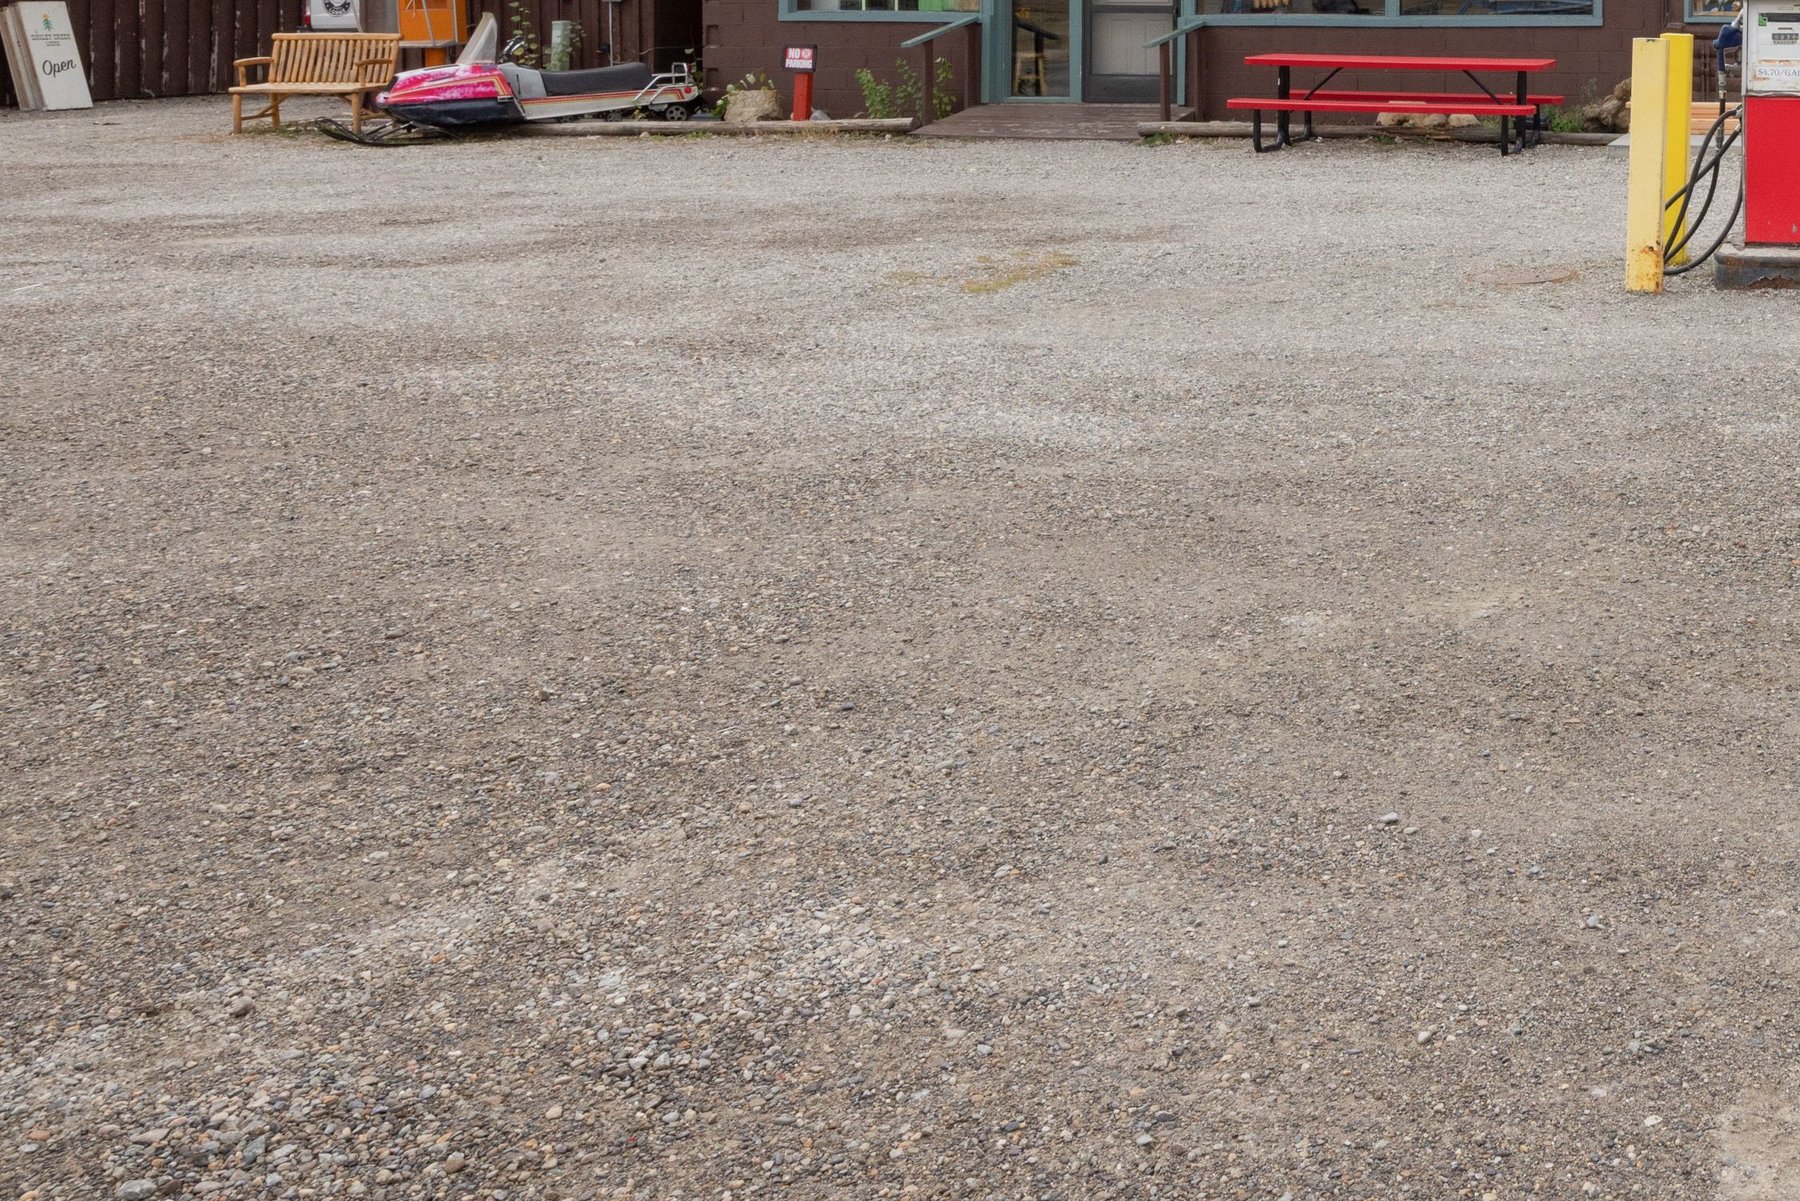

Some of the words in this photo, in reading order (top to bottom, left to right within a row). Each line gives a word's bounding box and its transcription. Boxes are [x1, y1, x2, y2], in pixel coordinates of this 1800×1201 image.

[788, 48, 800, 59] NO
[42, 59, 77, 78] Open
[785, 59, 812, 68] PARKING
